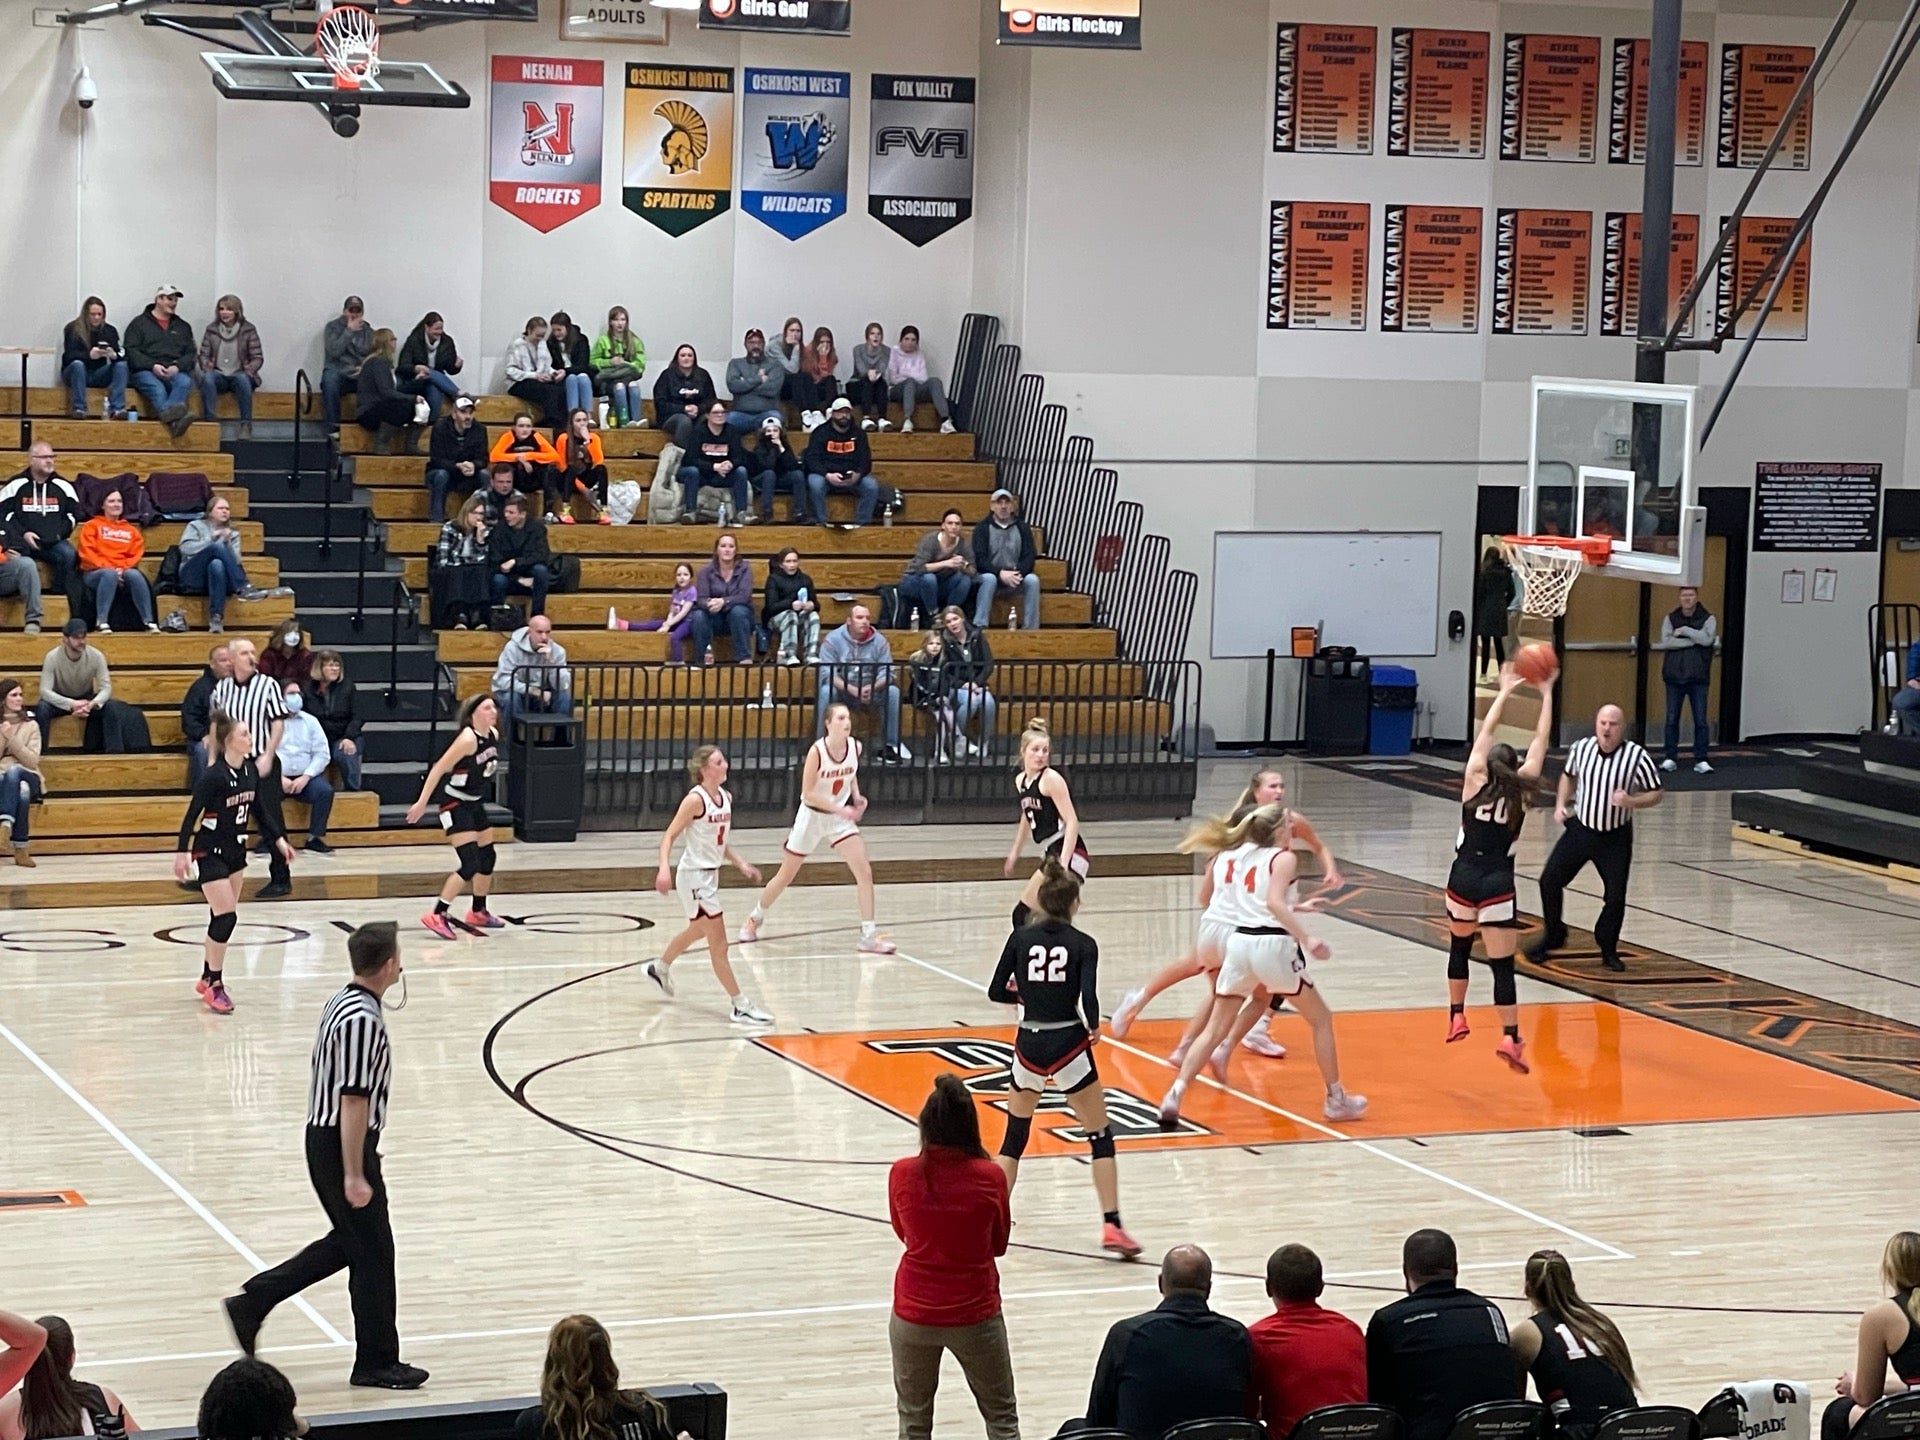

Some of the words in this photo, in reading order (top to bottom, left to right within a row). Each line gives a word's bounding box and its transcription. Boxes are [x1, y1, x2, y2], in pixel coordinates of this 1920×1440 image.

[587, 8, 646, 24] ADULTS
[740, 0, 776, 16] Girls
[778, 2, 809, 19] Golf
[1036, 15, 1070, 32] Girls
[1072, 17, 1123, 36] Hockey
[521, 62, 573, 81] NEENAH
[630, 68, 686, 86] OSHKOSH
[688, 72, 728, 89] NORTH
[752, 74, 807, 92] OSHKOSH
[808, 77, 842, 94] WEST
[893, 80, 915, 98] FOX
[916, 81, 954, 99] VALLEY
[1276, 27, 1297, 147] KAUKAUNA
[1390, 32, 1411, 150] KAUKAUNA
[1502, 37, 1523, 155] KAUKAUNA
[1611, 42, 1632, 159] KAUKAUNA
[1720, 48, 1740, 163] KAUKAUNA
[875, 126, 969, 159] FVA
[530, 152, 566, 165] NEENAH
[515, 186, 582, 205] ROCKETS
[643, 191, 716, 210] SPARTANS
[762, 195, 832, 214] WILDCATS
[882, 199, 957, 218] ASSOCIATION
[1269, 205, 1290, 323] KAUKAUNA
[1383, 209, 1404, 327] KAUKAUNA
[1494, 212, 1516, 329] KAUKAUNA
[1603, 216, 1624, 331] KAUKAUNA
[1758, 463, 1780, 474] THE
[1843, 464, 1881, 475] GHOST
[1027, 944, 1068, 982] 22
